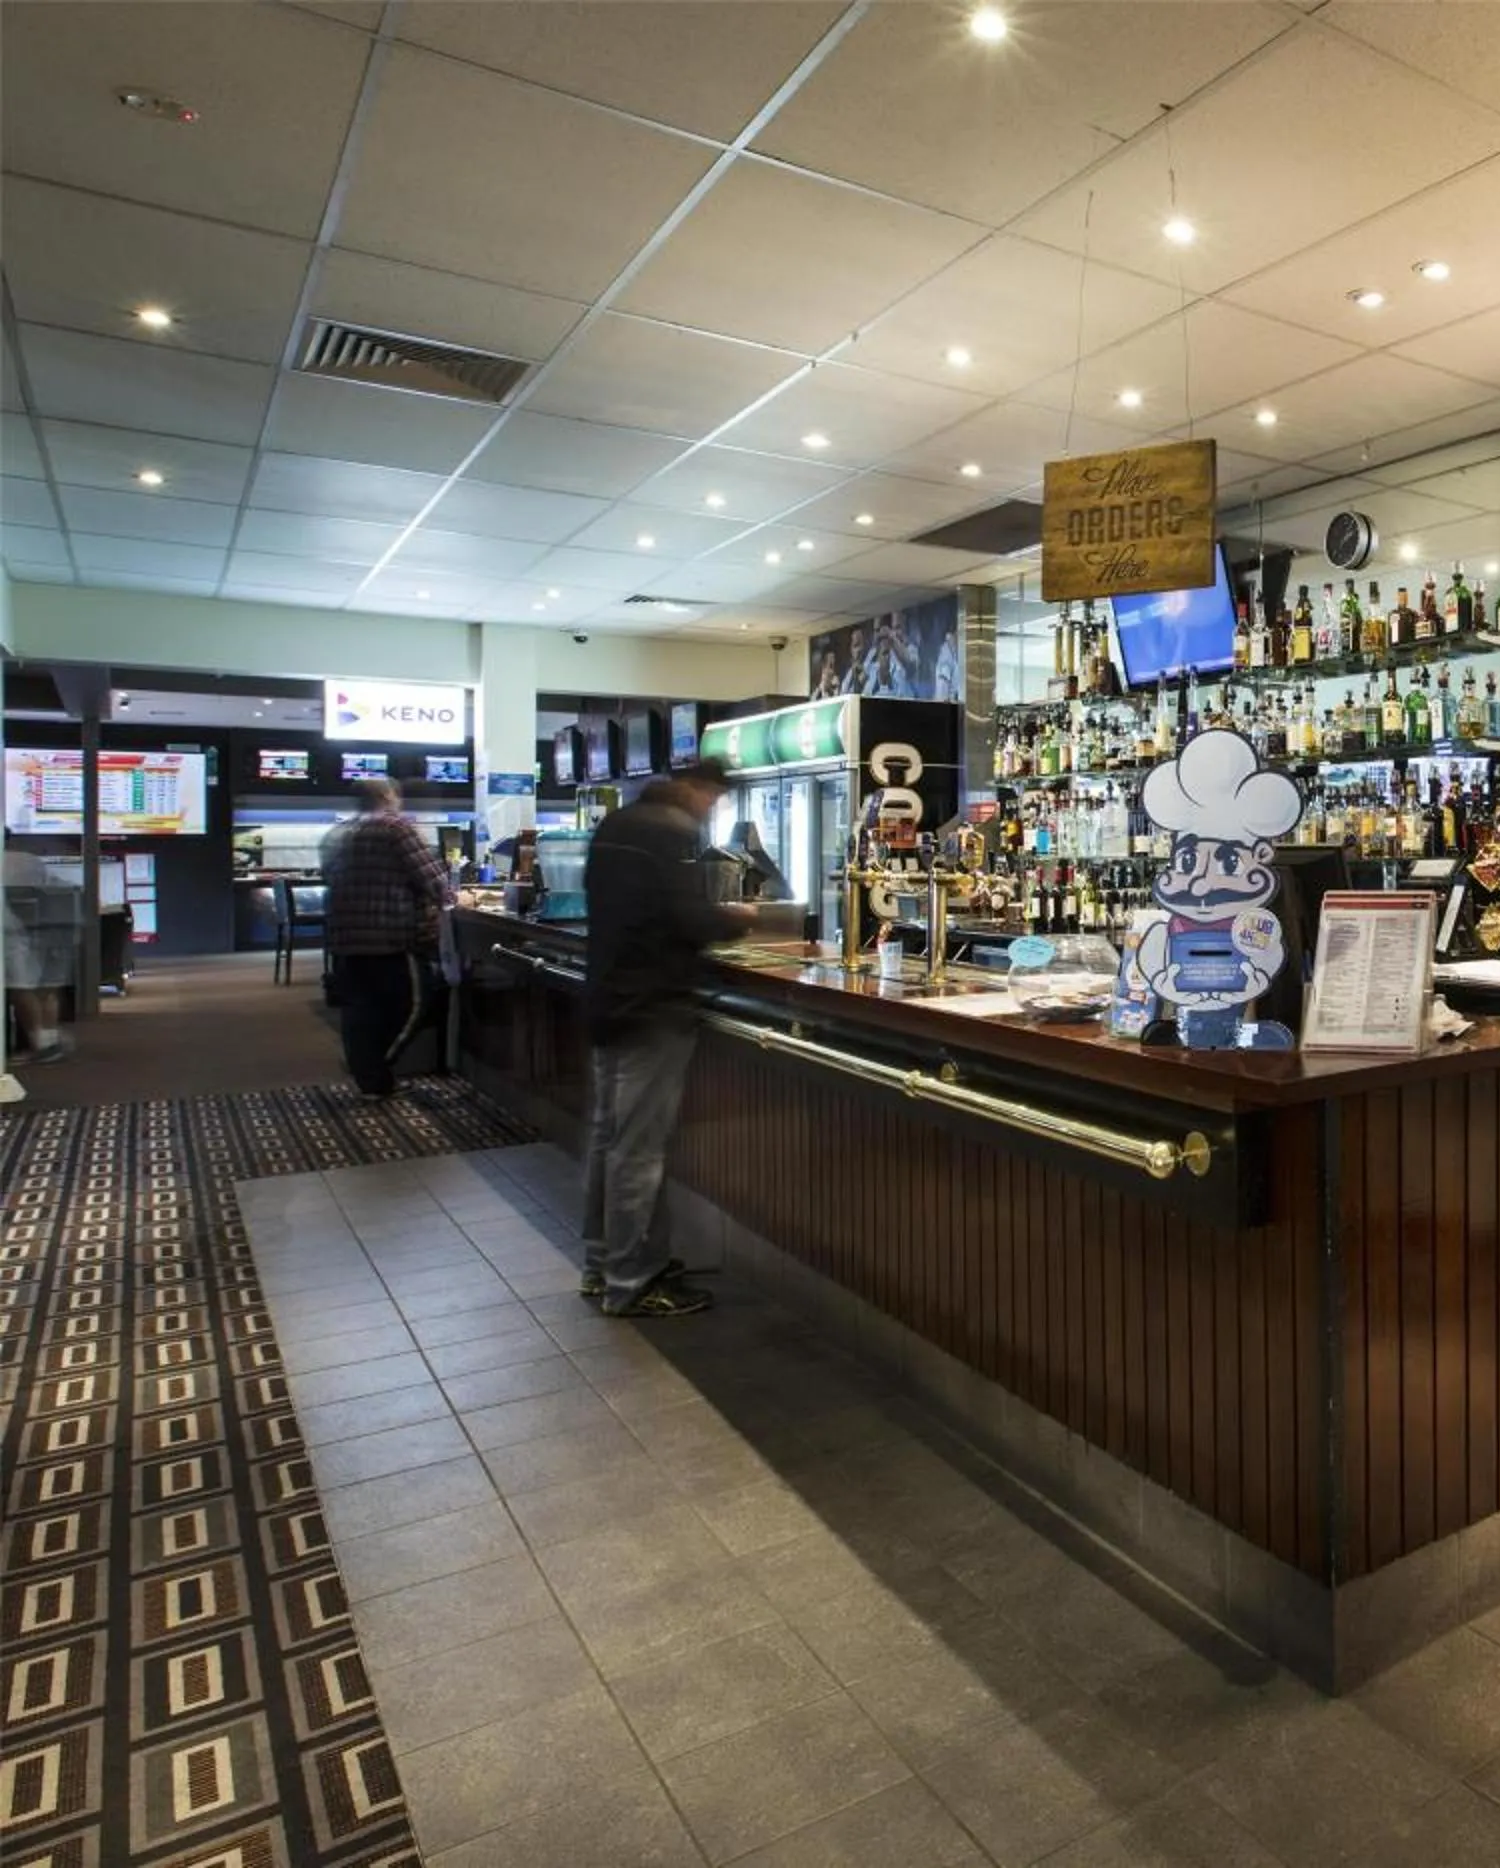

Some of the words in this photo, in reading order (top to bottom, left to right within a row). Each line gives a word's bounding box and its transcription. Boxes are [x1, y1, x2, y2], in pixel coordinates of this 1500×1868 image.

[1066, 496, 1187, 547] ORDERS
[1084, 544, 1150, 585] Here
[381, 705, 455, 724] KENO
